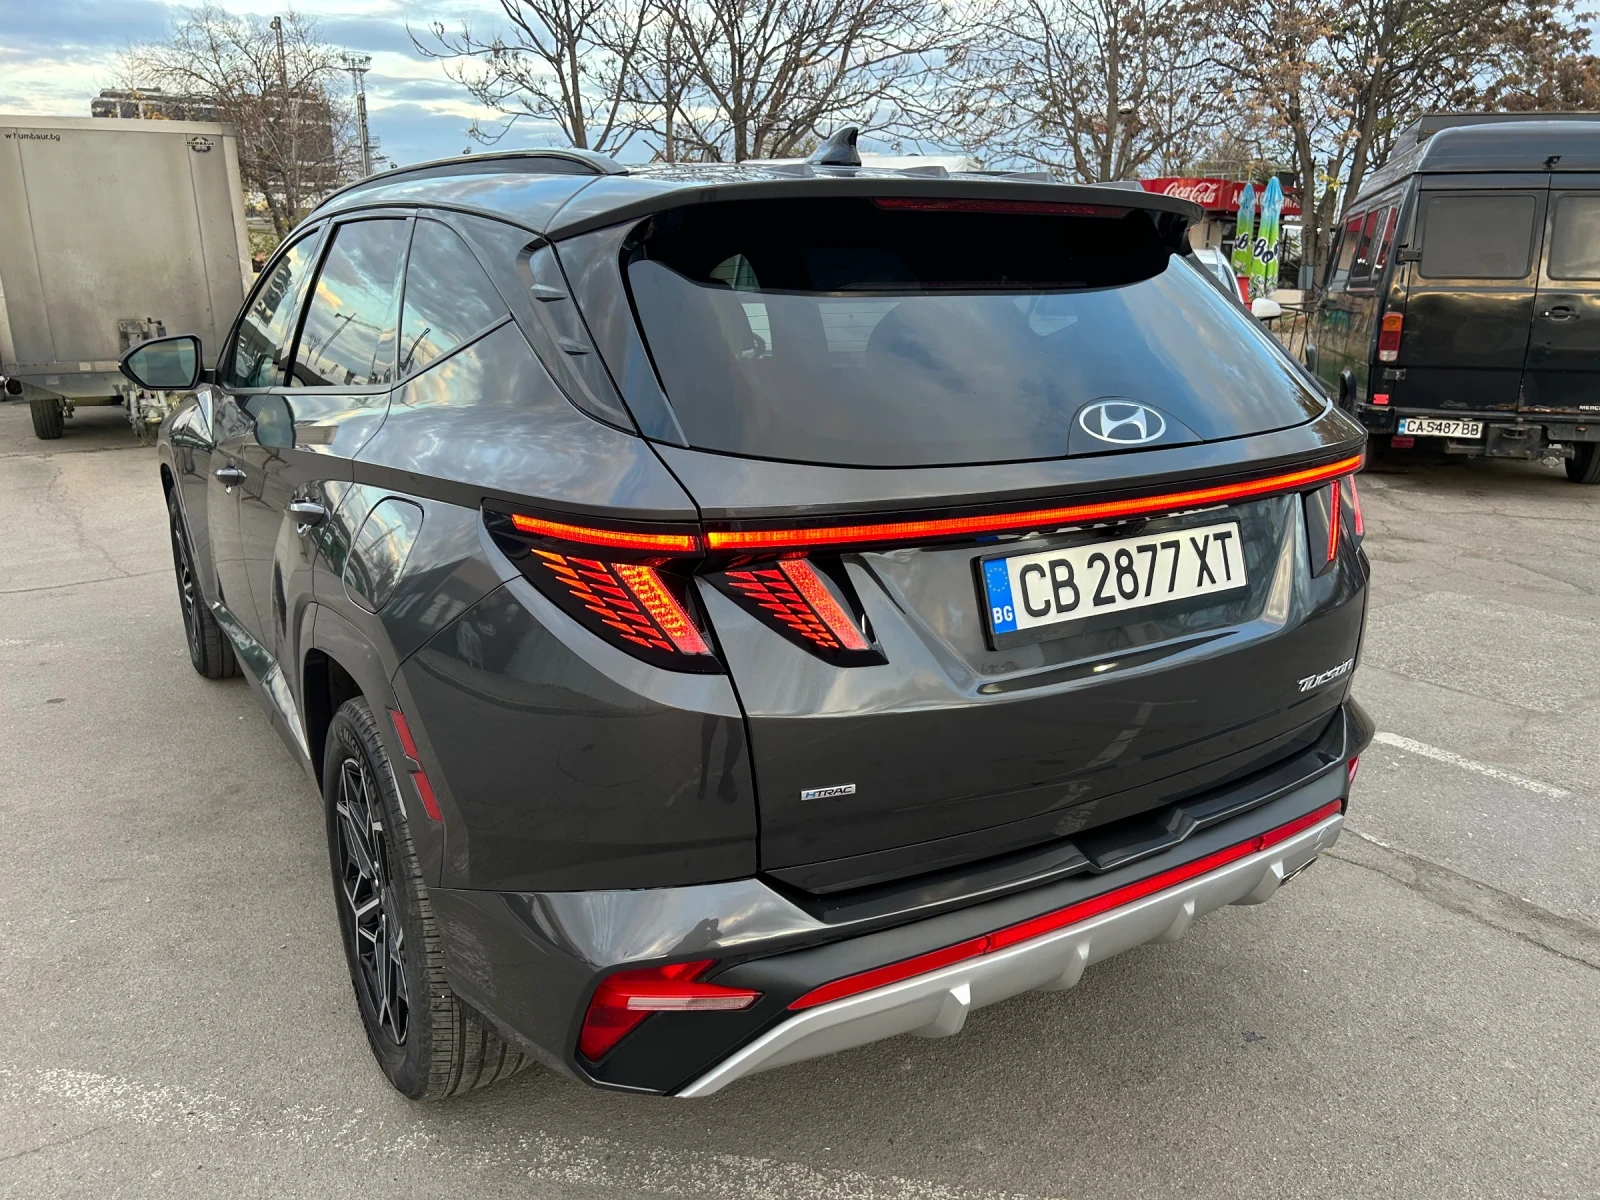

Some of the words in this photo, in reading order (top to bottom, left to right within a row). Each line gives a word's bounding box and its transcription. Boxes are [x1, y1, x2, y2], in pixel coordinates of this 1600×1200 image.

[1406, 420, 1424, 433] CA
[1426, 421, 1459, 435] 5487
[1461, 423, 1479, 436] BB
[1019, 558, 1081, 618] CB
[1086, 539, 1181, 607] 2877
[1189, 531, 1233, 588] XT
[993, 606, 1013, 624] BG
[805, 785, 853, 799] HTRAC
